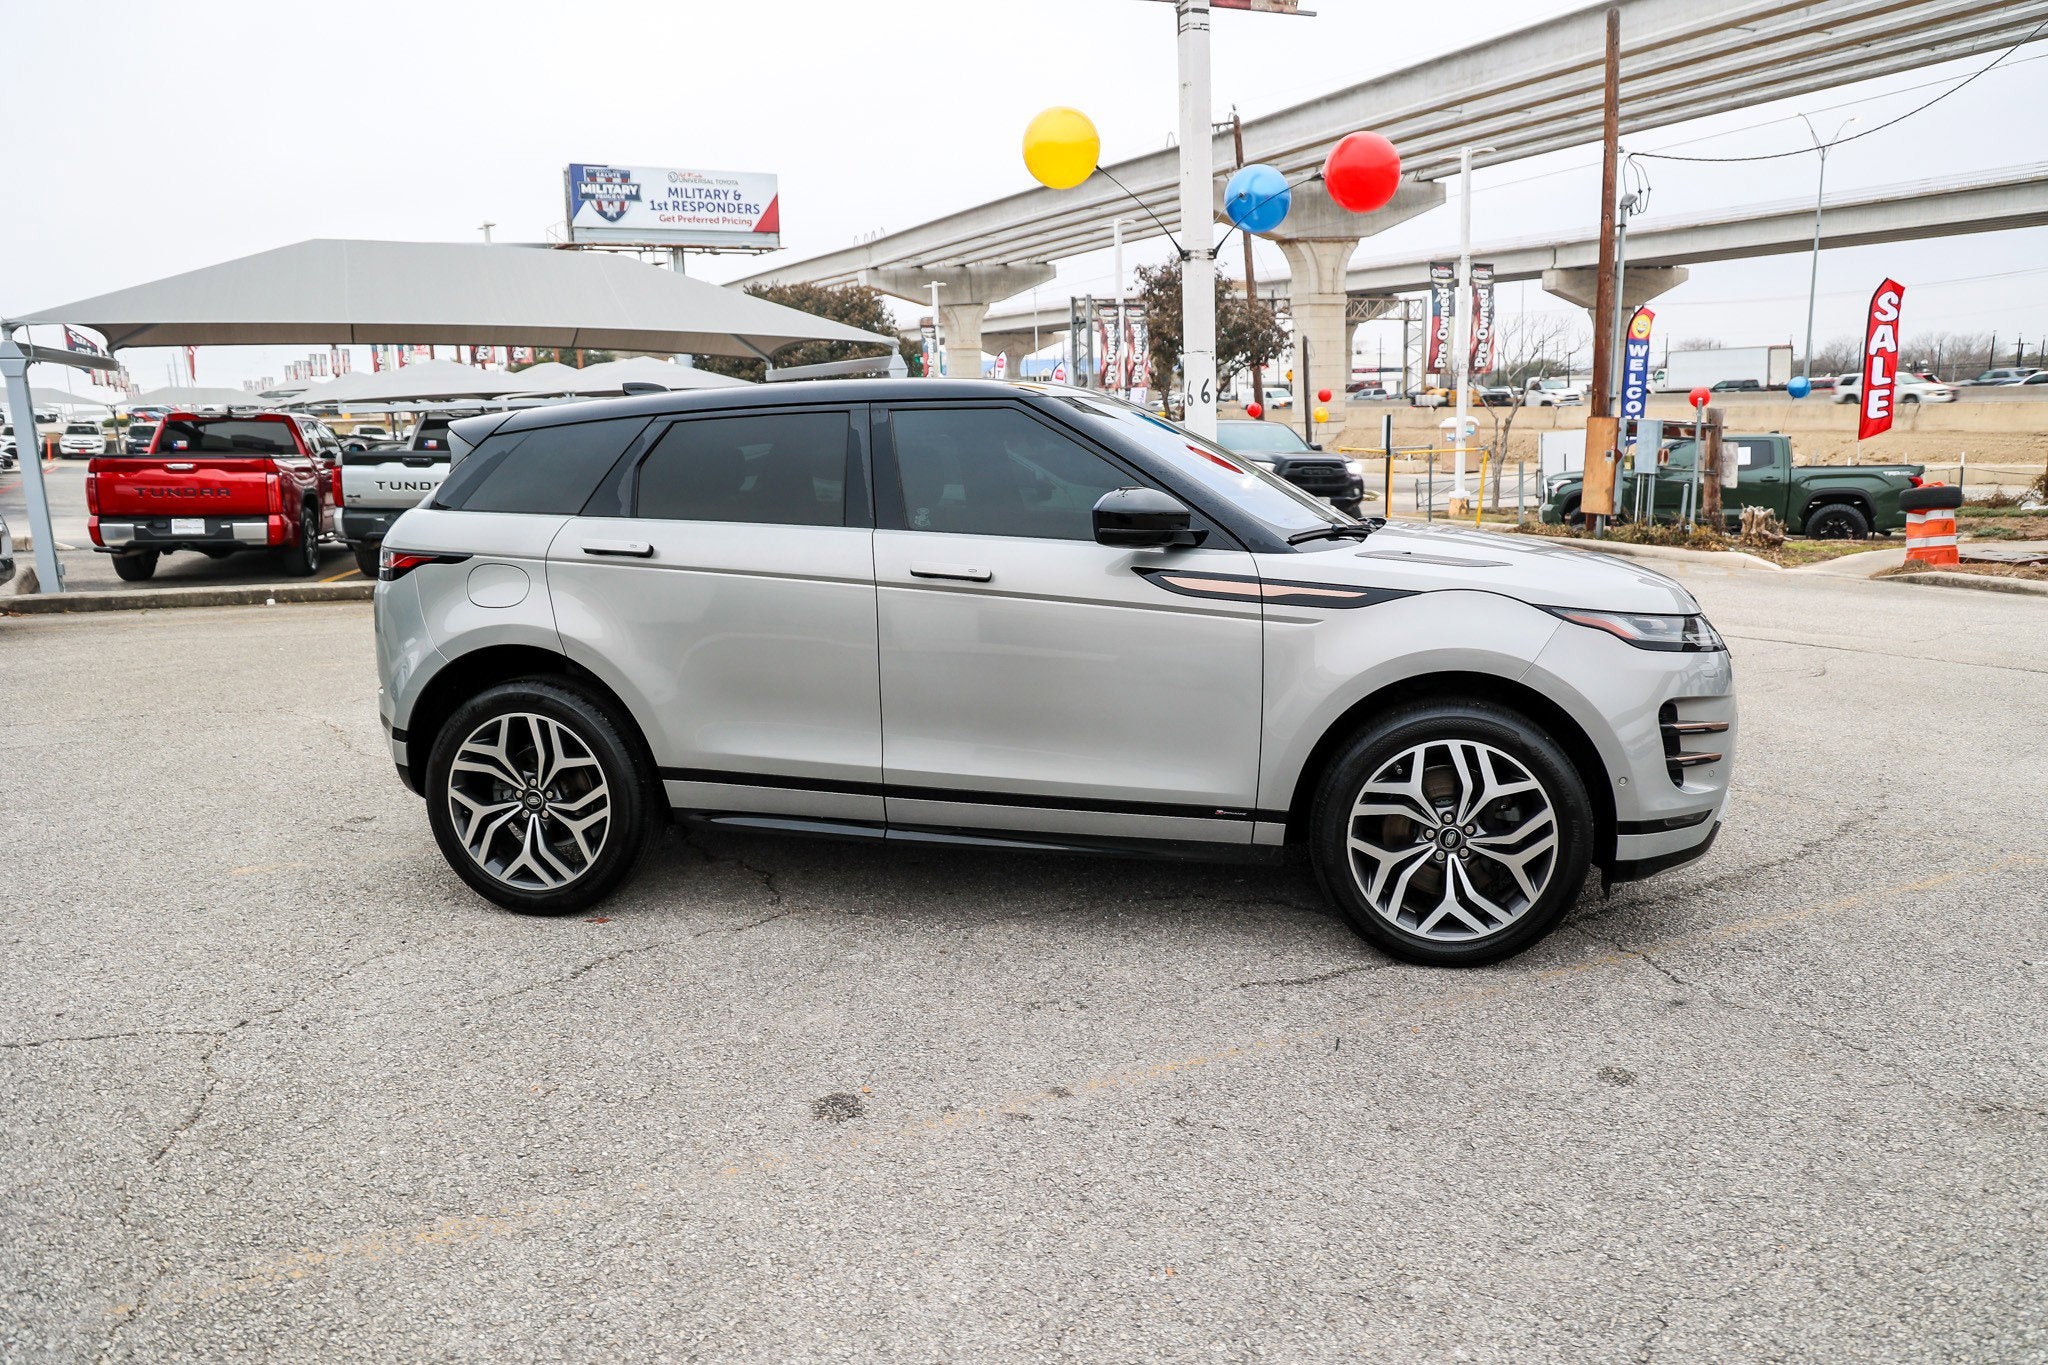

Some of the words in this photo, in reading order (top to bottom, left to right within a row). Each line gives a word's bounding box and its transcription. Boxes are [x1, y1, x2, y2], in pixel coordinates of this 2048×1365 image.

[580, 183, 639, 195] MILITARY
[679, 177, 714, 185] UNIVERSAL
[667, 187, 730, 200] MILITARY
[733, 190, 742, 201] &
[650, 200, 668, 211] 1st
[672, 200, 760, 215] RESPONDERS
[659, 214, 676, 223] Get
[677, 215, 720, 224] Preferred
[722, 216, 753, 227] Pricing
[1437, 288, 1450, 341] Owned
[1476, 288, 1490, 341] Owned
[1104, 323, 1116, 364] Owned
[1131, 323, 1143, 364] Owned
[1434, 342, 1448, 368] Pre
[1474, 342, 1488, 368] Pre
[1867, 291, 1899, 419] SALE
[1104, 364, 1116, 385] Pre
[1131, 364, 1143, 385] Pre
[1625, 344, 1649, 421] WELCO
[134, 487, 231, 498] TUNDRA
